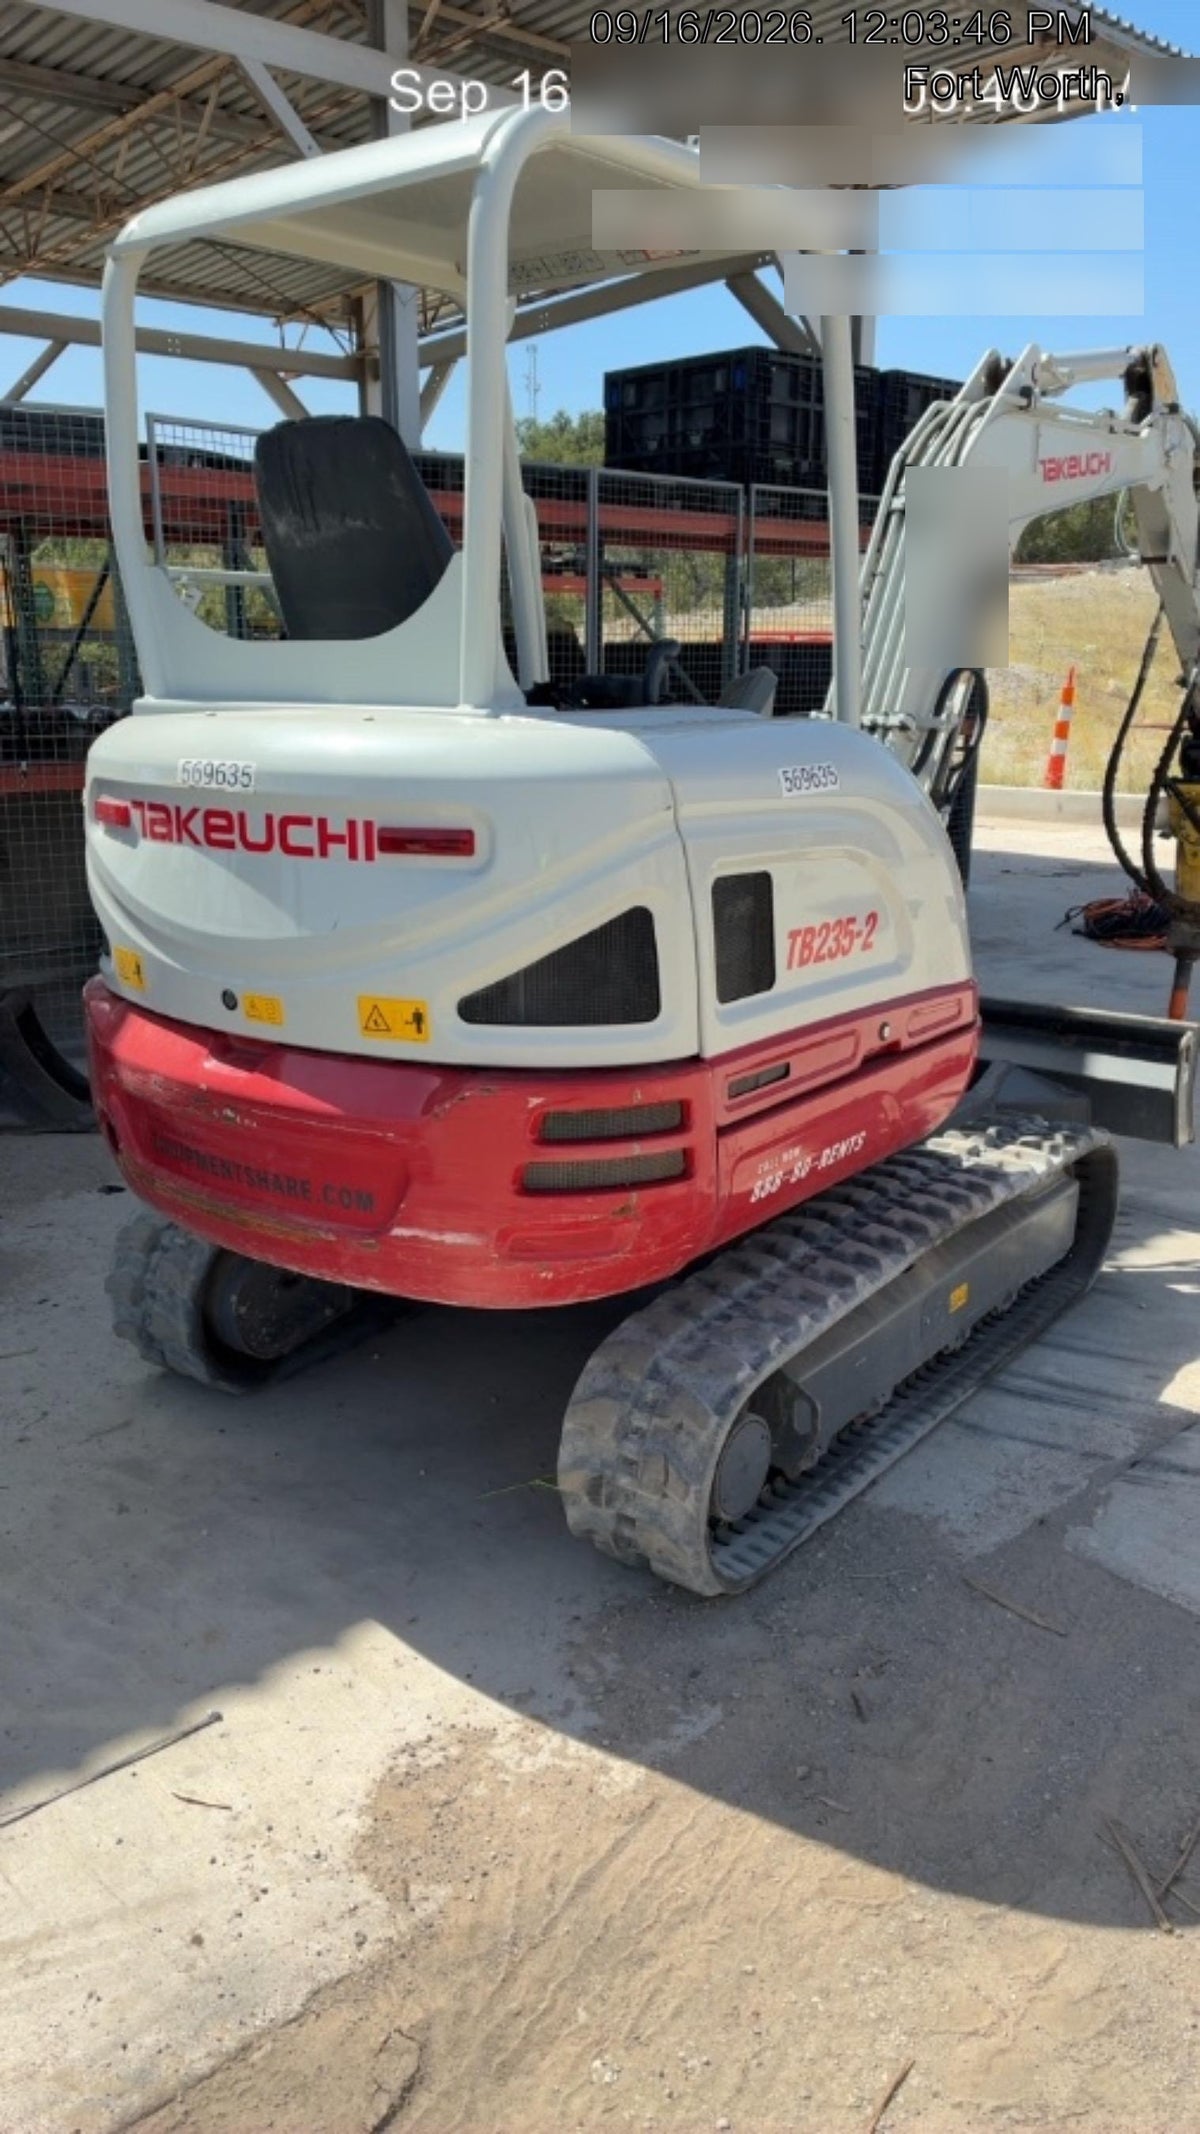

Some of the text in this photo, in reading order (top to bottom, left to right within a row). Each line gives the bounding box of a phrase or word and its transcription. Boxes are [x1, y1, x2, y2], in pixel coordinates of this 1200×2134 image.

[182, 760, 253, 788] 569635
[782, 765, 838, 793] 569635
[786, 911, 879, 970] TB235-2
